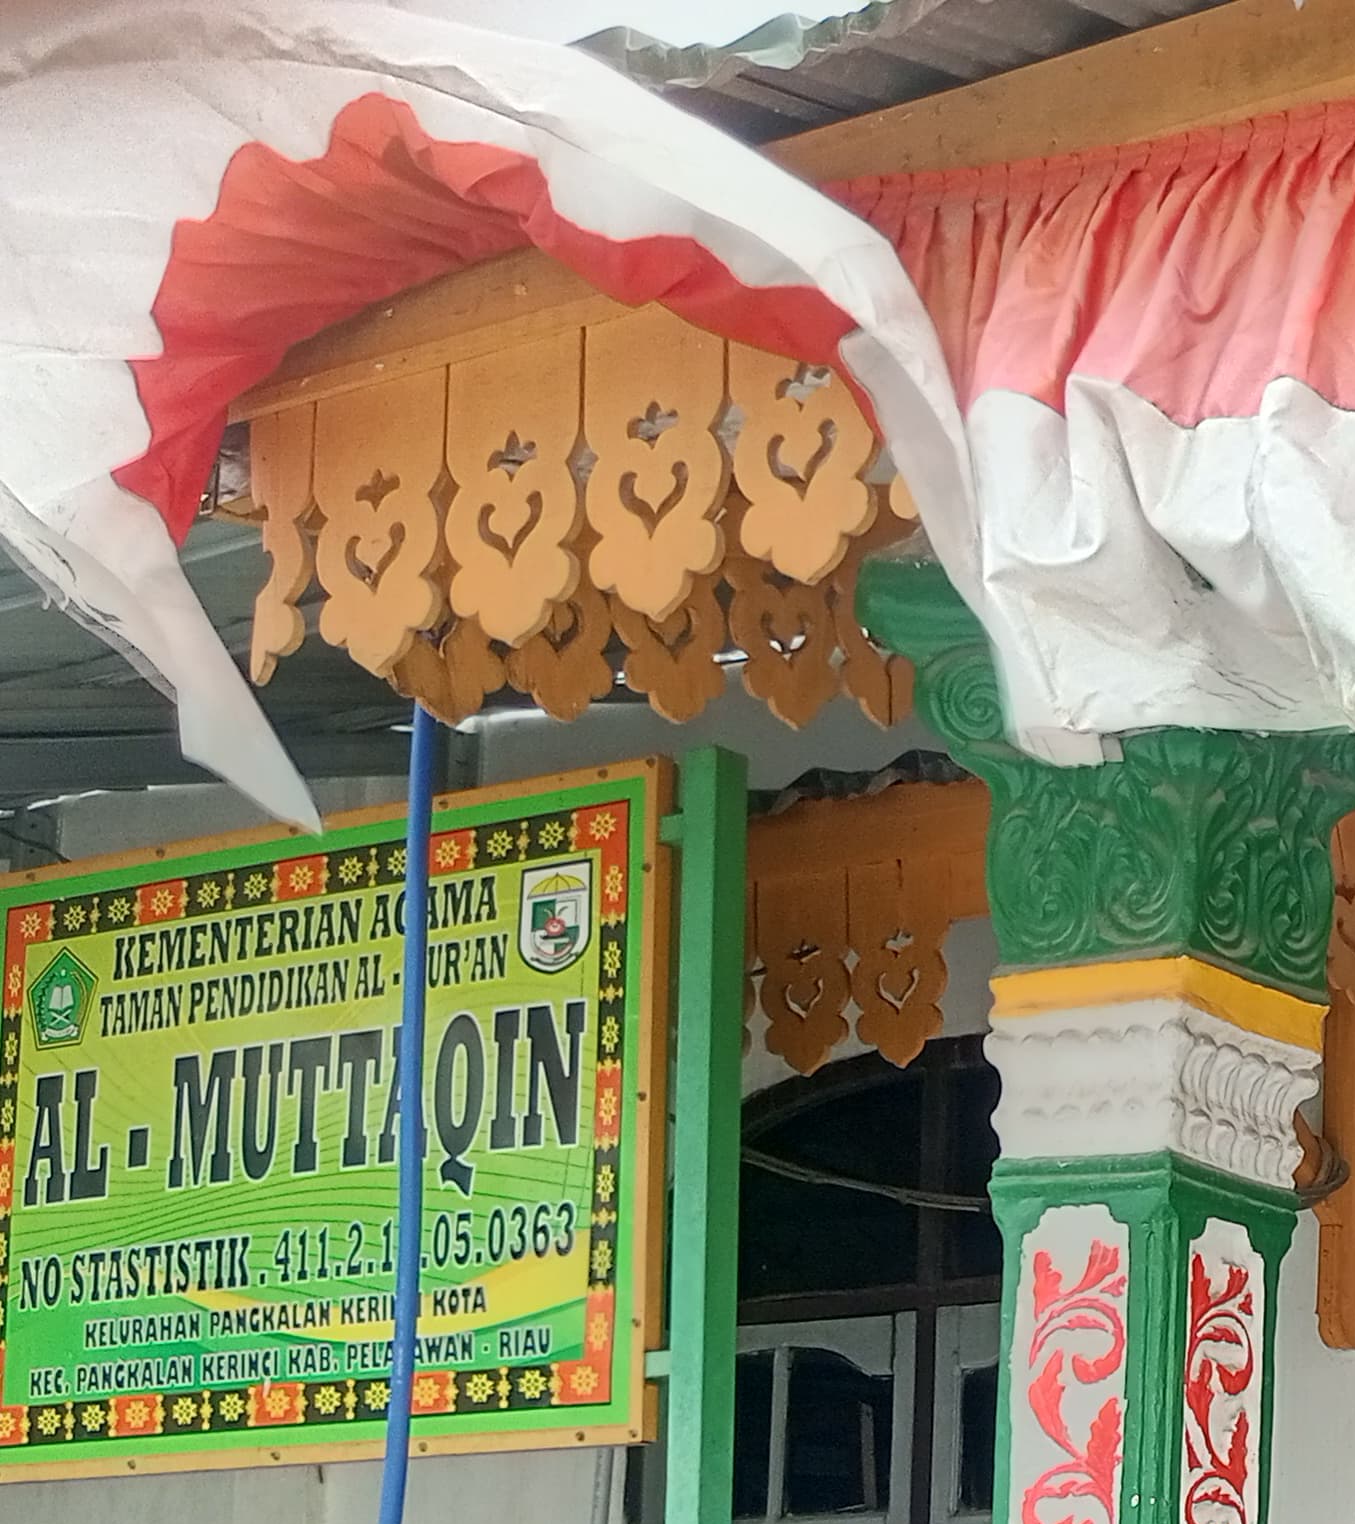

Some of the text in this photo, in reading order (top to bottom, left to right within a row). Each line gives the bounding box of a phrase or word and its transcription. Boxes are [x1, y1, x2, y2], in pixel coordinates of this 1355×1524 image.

[113, 898, 362, 980] KEMENTERIAN
[100, 984, 183, 1037] TAMAN
[188, 958, 349, 1025] PENDIDIKAN
[354, 954, 385, 1000] AL
[428, 934, 508, 988] UR'AN
[24, 1068, 110, 1207] AL
[19, 1257, 62, 1310] NO
[70, 1236, 250, 1304] STASTISTIK
[274, 1202, 575, 1282] 411.2.1.05.0363
[30, 1367, 69, 1398] KEC.
[77, 1355, 194, 1392] PANGKALAN
[201, 1349, 280, 1382] KERINCI
[289, 1345, 338, 1375] KAB.
[500, 1327, 551, 1358] RIAU
[84, 1313, 201, 1348] KELURAHAN
[210, 1299, 330, 1337] PANGKALAN
[433, 1286, 486, 1316] KOTA
